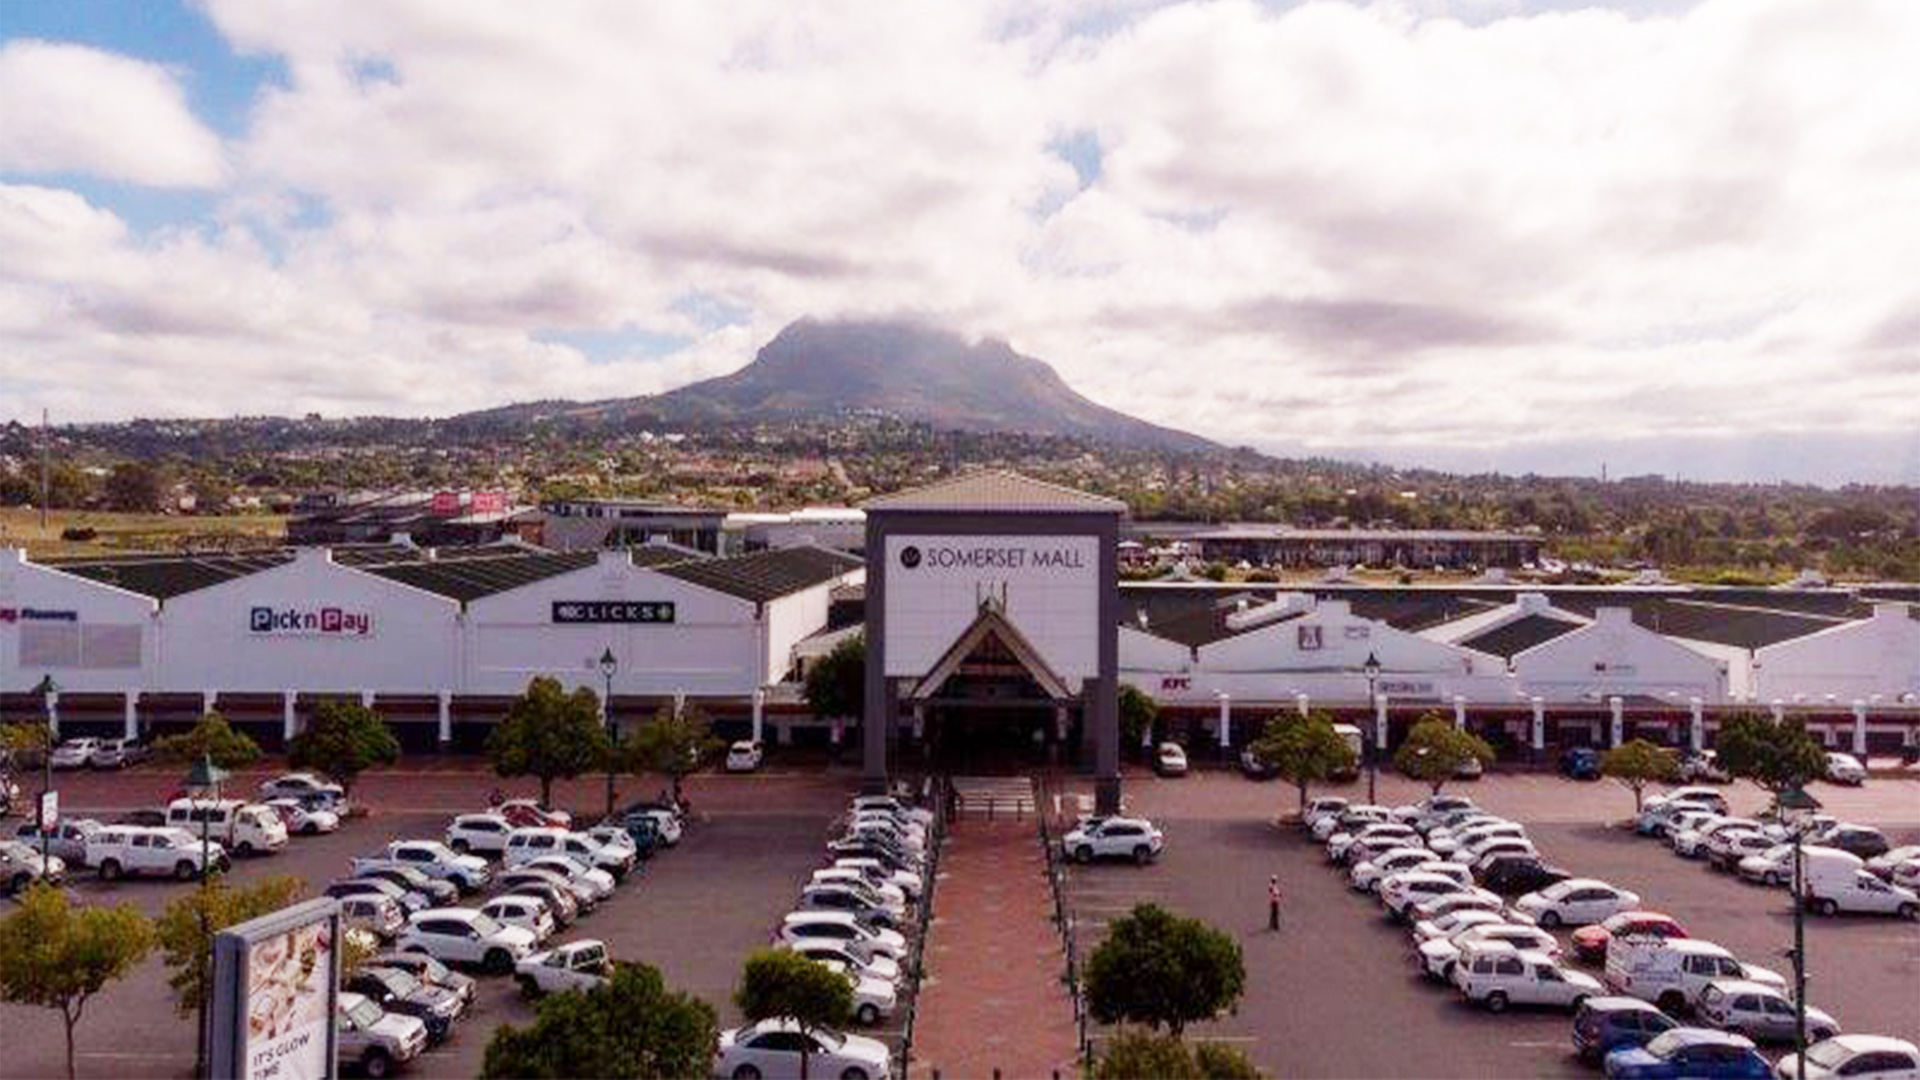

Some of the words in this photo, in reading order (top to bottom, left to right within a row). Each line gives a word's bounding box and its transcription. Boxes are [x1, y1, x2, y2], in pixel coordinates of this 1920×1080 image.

[927, 548, 1025, 568] SOMERSET
[1032, 548, 1085, 568] MALL
[251, 607, 301, 631] Pick
[321, 607, 368, 634] Pay
[575, 604, 655, 619] CLICKS
